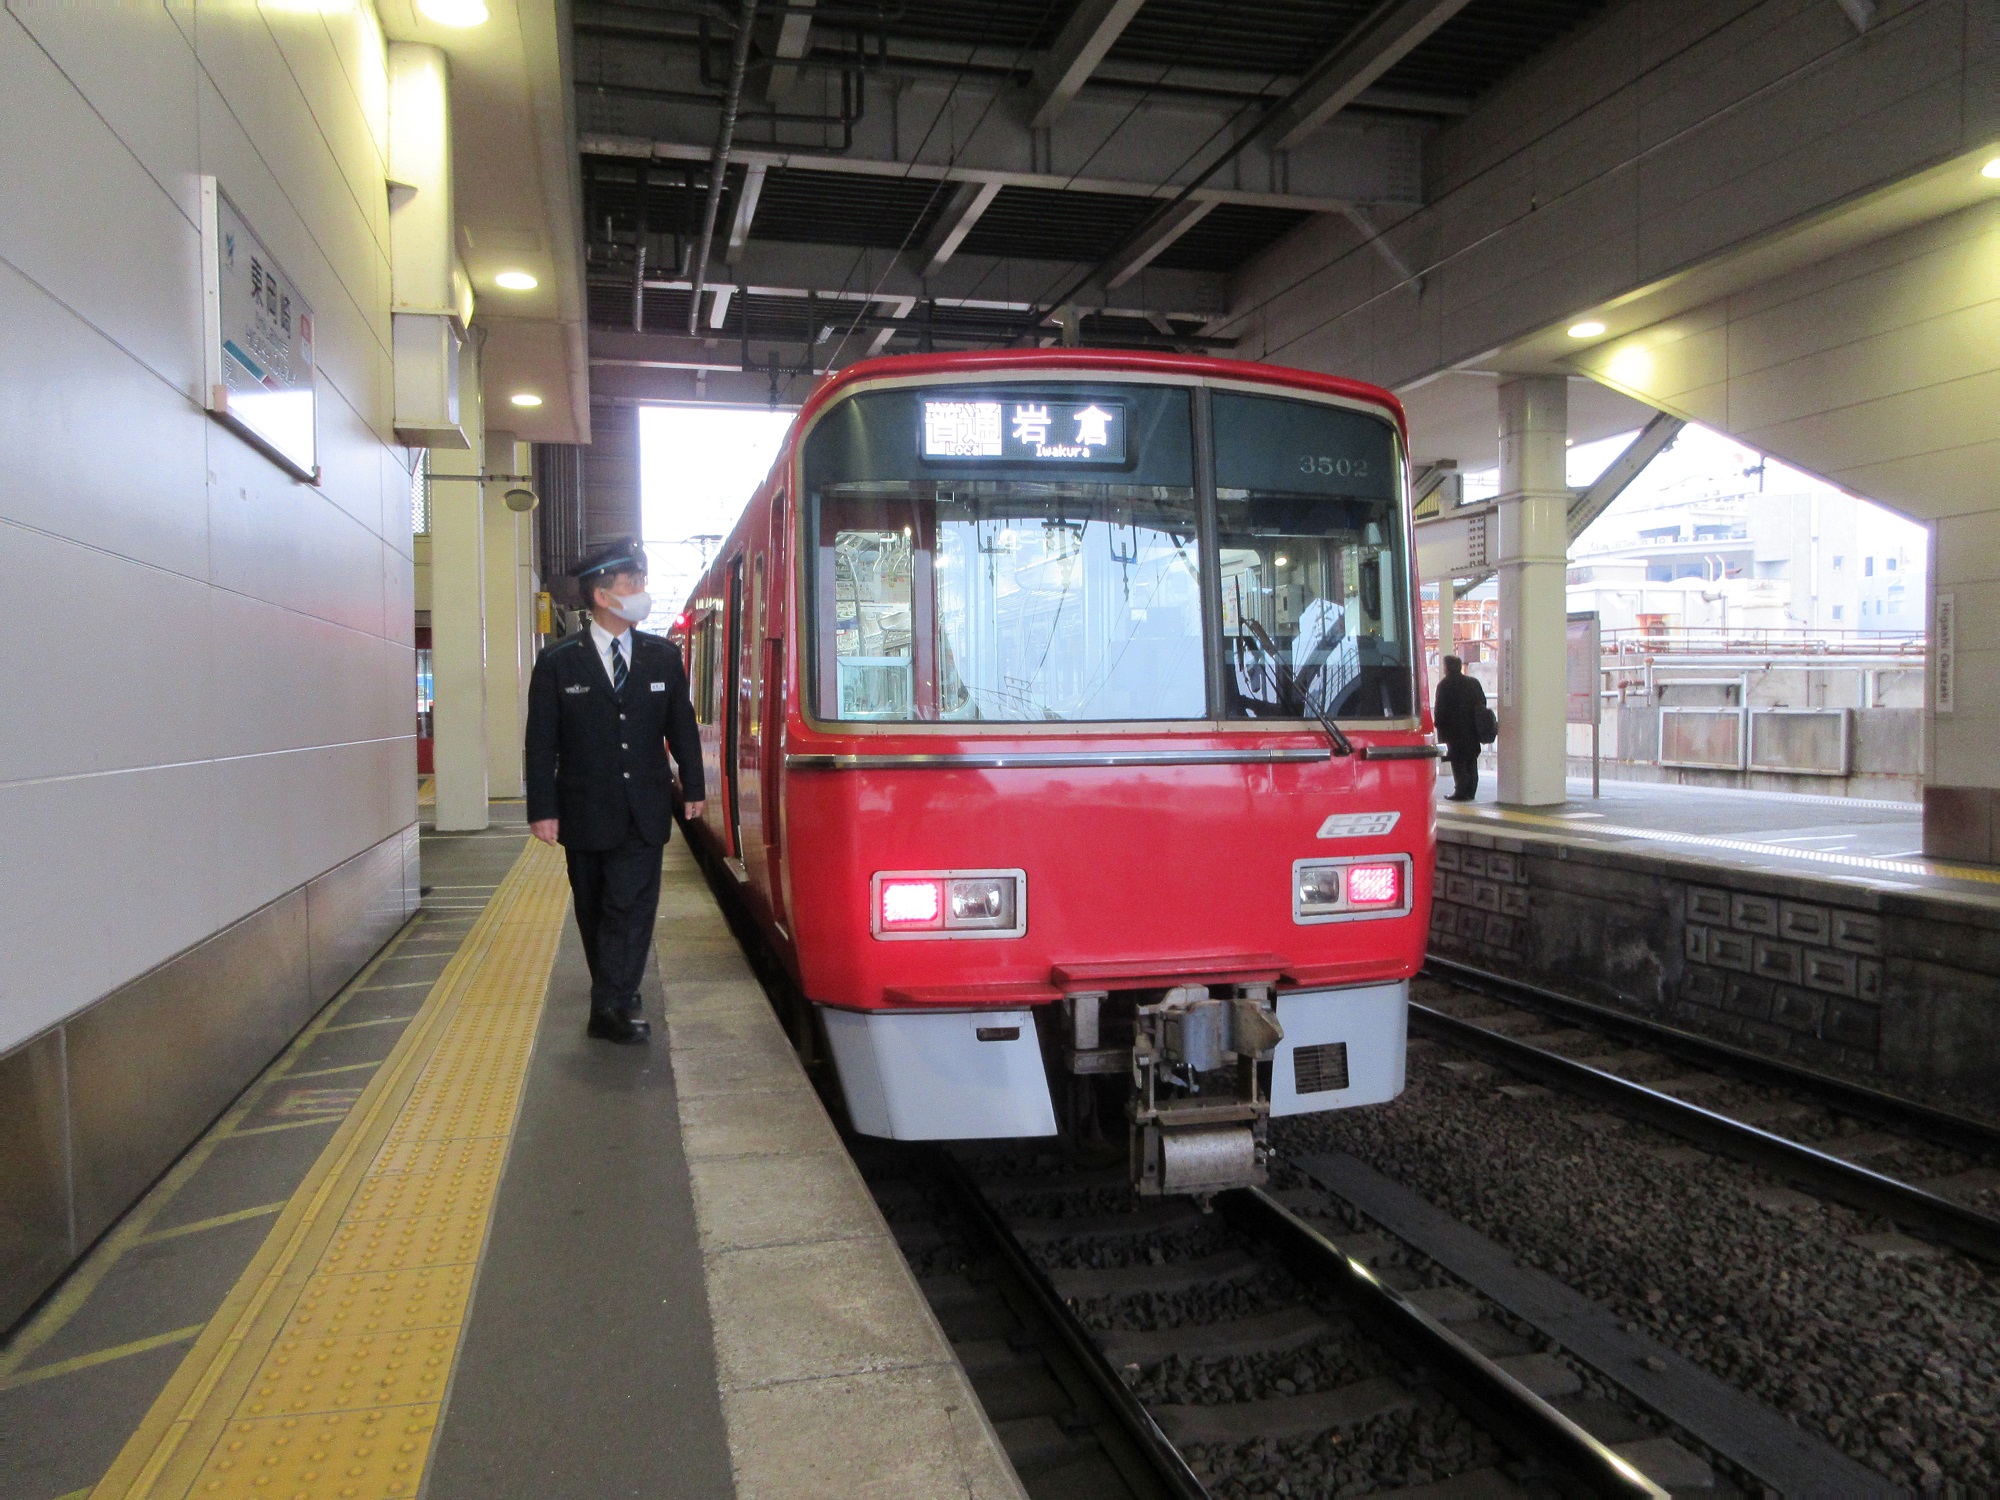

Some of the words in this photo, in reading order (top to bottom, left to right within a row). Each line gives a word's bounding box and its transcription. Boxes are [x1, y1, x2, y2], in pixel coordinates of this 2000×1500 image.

[945, 442, 983, 456] Local
[1035, 443, 1090, 458] Iwakura
[1300, 454, 1368, 477] 3502
